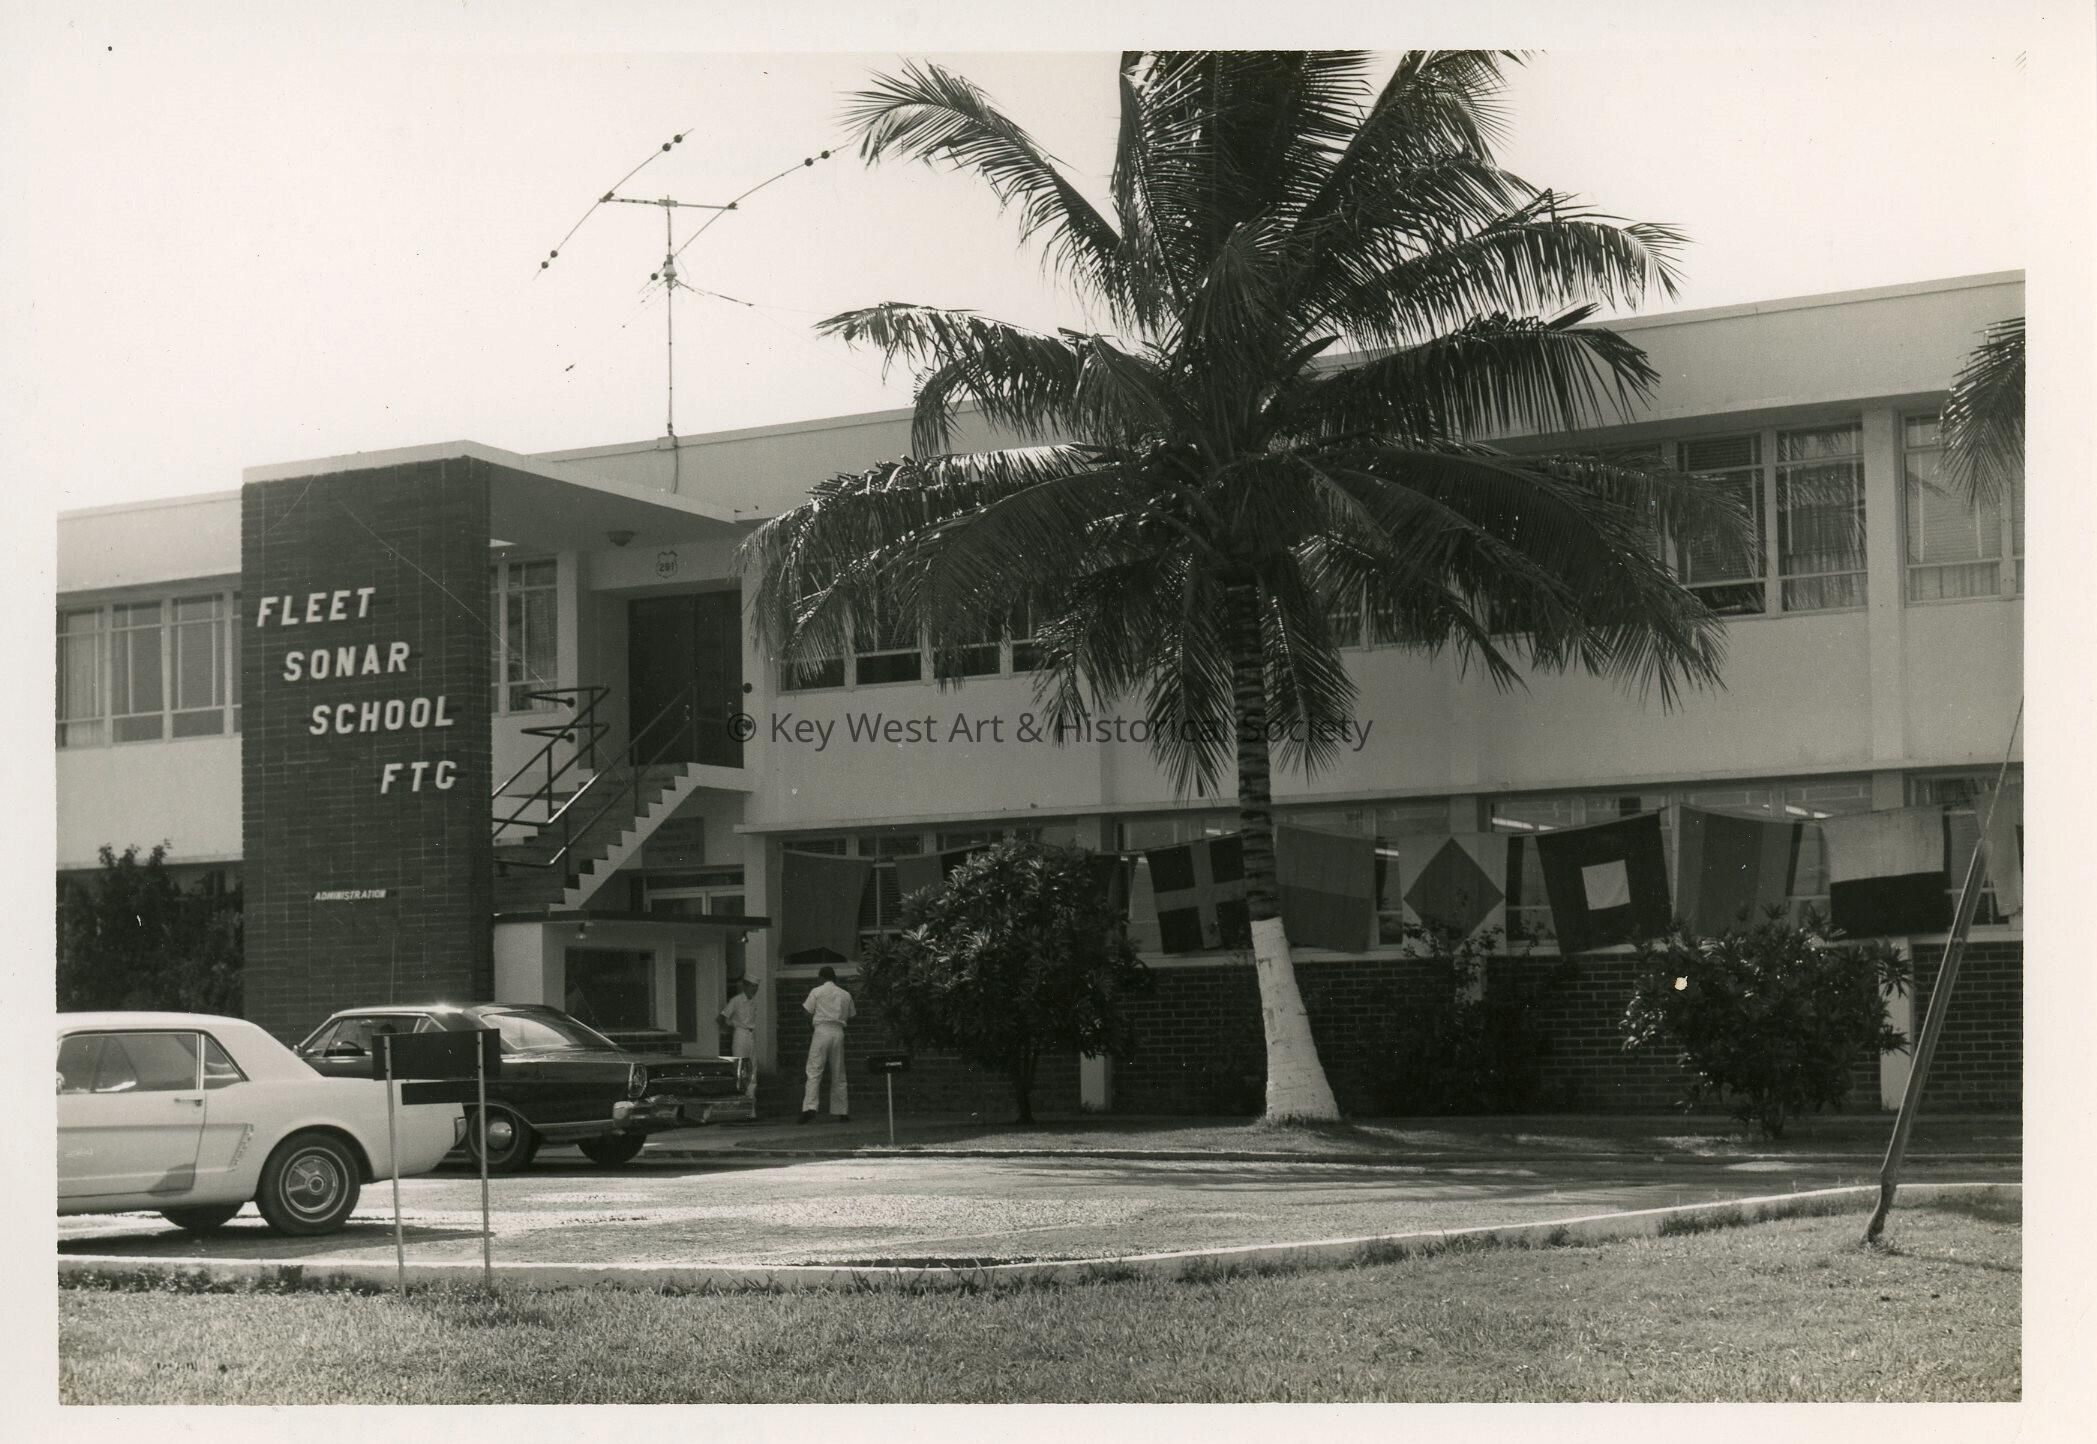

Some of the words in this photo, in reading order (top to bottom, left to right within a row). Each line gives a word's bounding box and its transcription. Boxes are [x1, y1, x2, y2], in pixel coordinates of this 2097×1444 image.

[256, 586, 376, 628] FLEET
[283, 641, 410, 682] SONAR
[309, 695, 455, 735] SCHOOL
[380, 760, 457, 794] FTG
[314, 889, 387, 901] ADMINISTRATION
